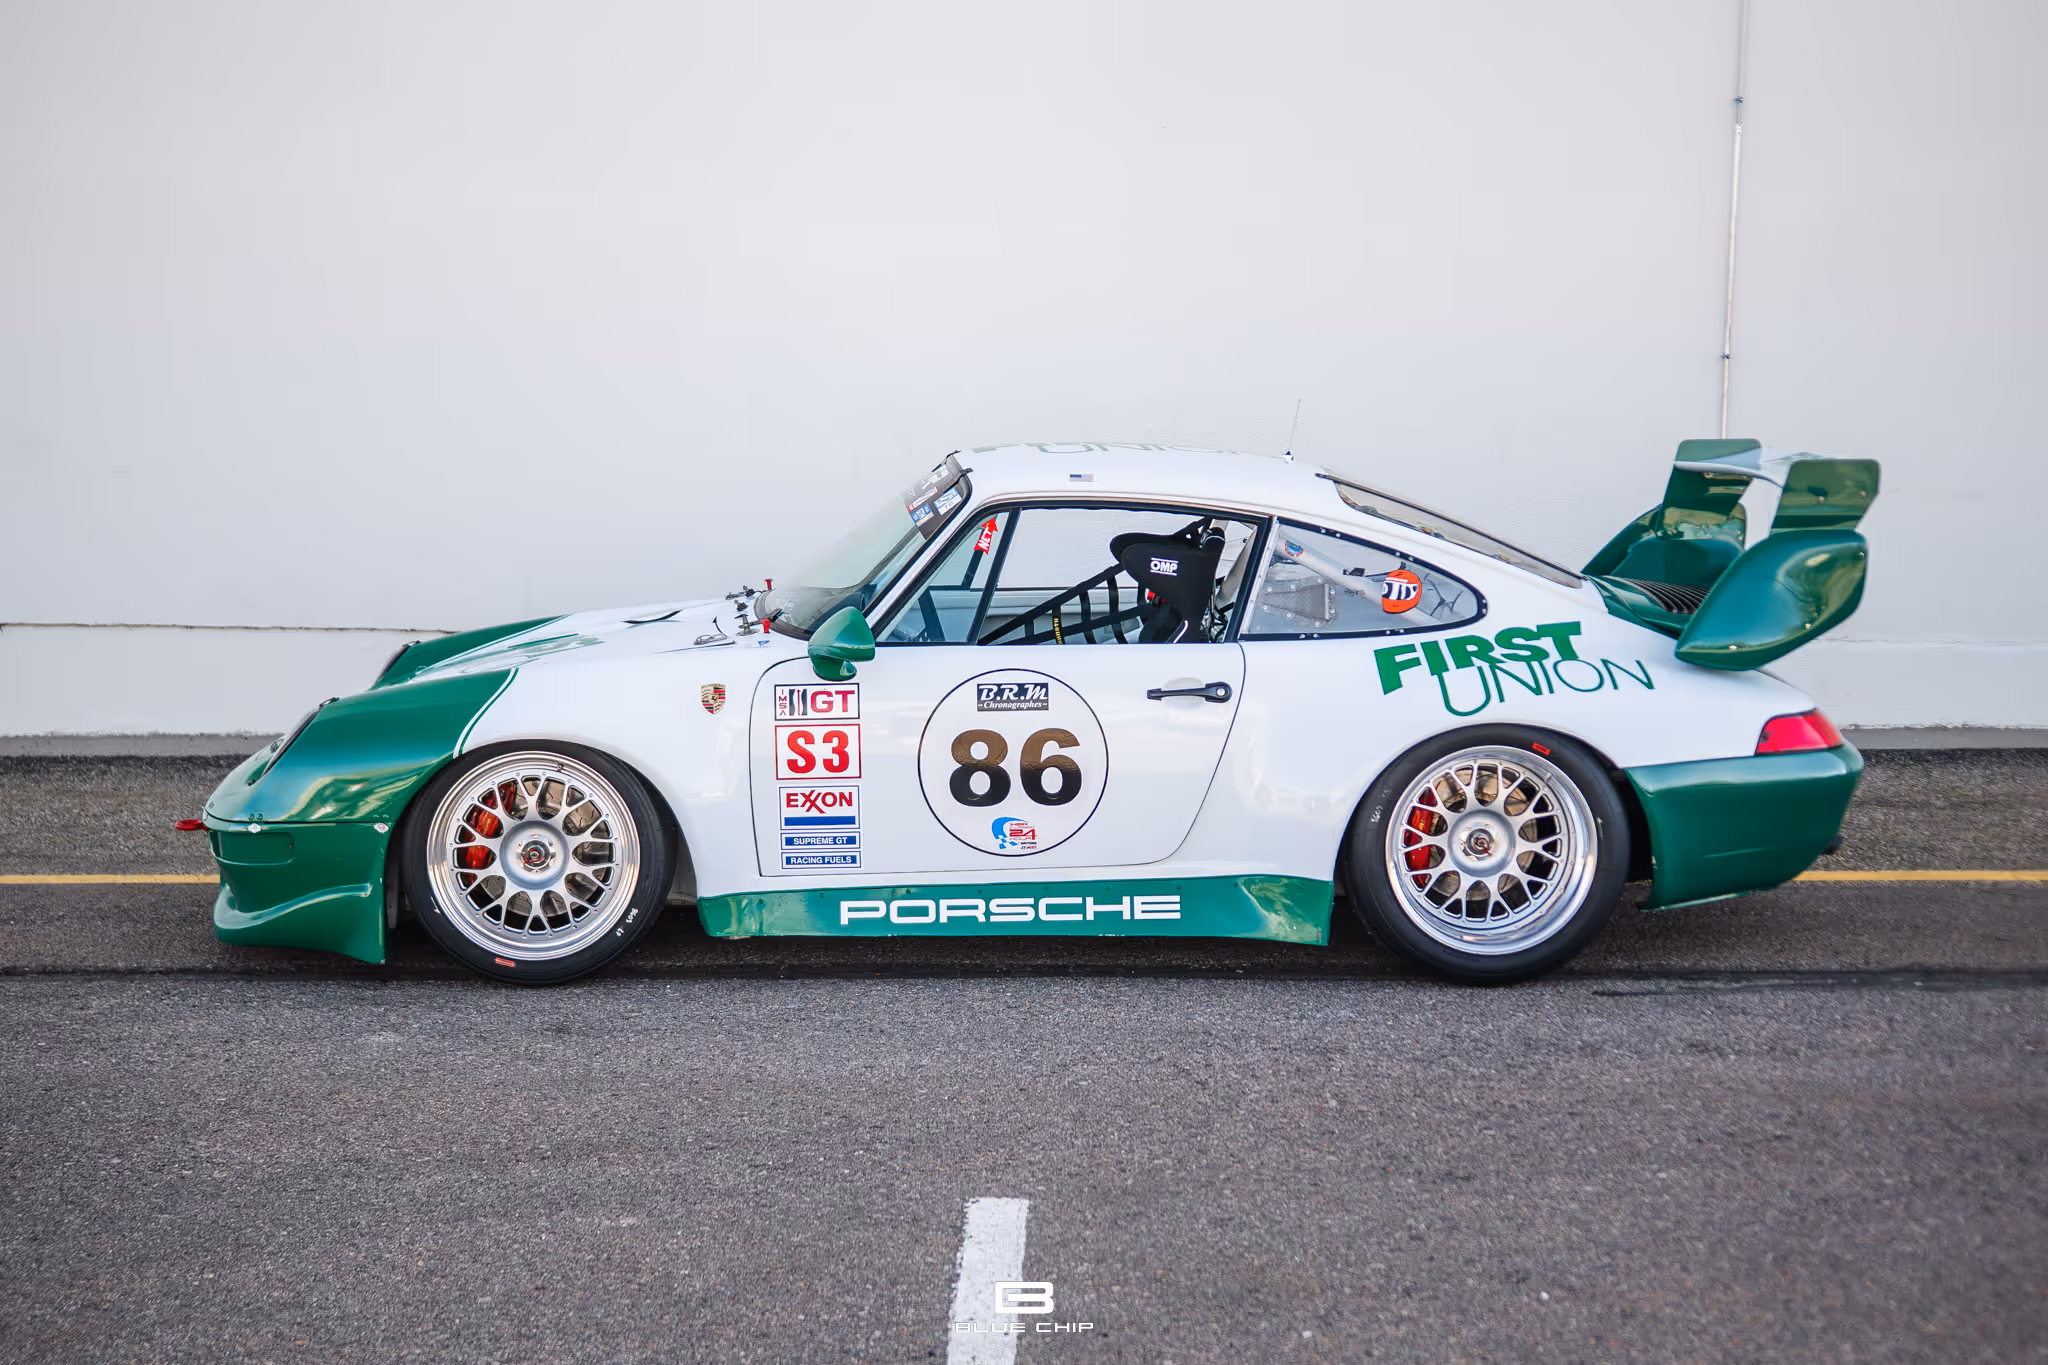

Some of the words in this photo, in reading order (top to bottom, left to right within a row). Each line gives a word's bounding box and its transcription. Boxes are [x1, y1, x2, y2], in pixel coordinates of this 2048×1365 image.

[977, 526, 992, 551] NET
[1150, 560, 1178, 573] OMP
[1373, 621, 1582, 695] FIRST
[979, 684, 1048, 701] B.R.M
[1434, 658, 1656, 717] UNION
[810, 690, 855, 713] GT
[983, 700, 1042, 710] Chronographes
[787, 730, 850, 774] S3
[949, 727, 1082, 807] 86
[786, 790, 853, 814] EXXON
[793, 837, 834, 845] SUPREME
[836, 836, 848, 844] GT
[1009, 829, 1036, 840] 24
[790, 856, 823, 864] RACING
[824, 856, 852, 864] FUELS
[840, 895, 1181, 925] PORSCHE
